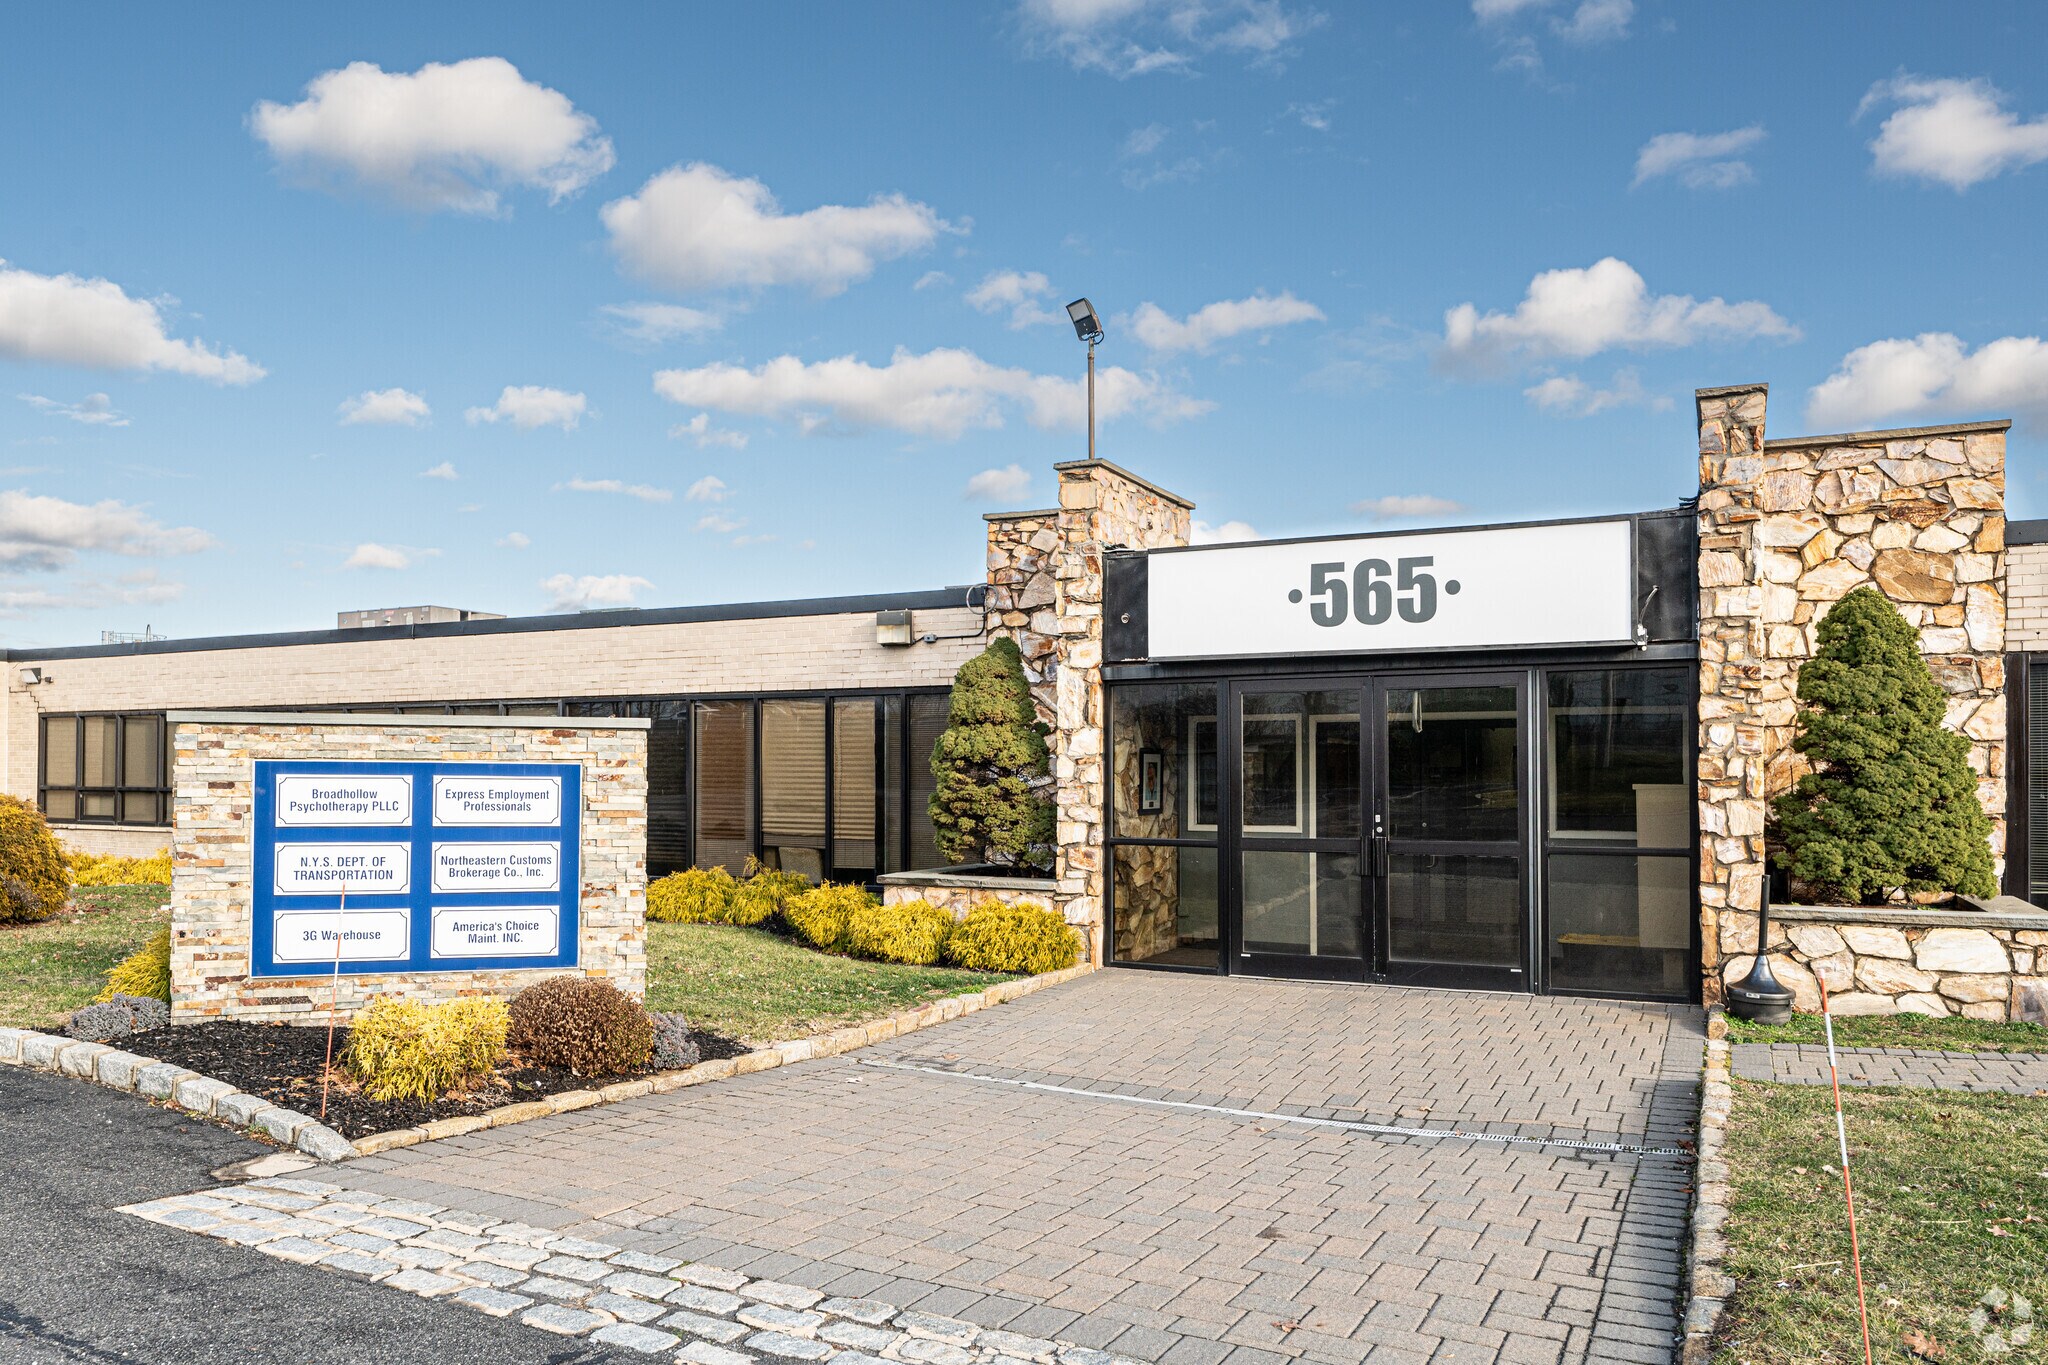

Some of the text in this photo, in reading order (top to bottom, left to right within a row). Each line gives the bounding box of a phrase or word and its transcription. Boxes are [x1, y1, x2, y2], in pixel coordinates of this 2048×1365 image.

[312, 788, 378, 799] Broadhollow
[445, 788, 550, 801] Express Employment
[290, 800, 399, 814] Psychotherapy PLLC
[463, 801, 532, 812] Professionals
[300, 856, 386, 868] N.Y.S. DEPT. OF
[440, 854, 552, 866] Northeastern Customs
[293, 869, 393, 881] TRANSPORTATION
[449, 866, 544, 880] Brokerage Co., Inc.
[452, 920, 540, 932] America's Choice
[302, 930, 317, 941] 3G
[468, 932, 523, 944] Maint. INC.
